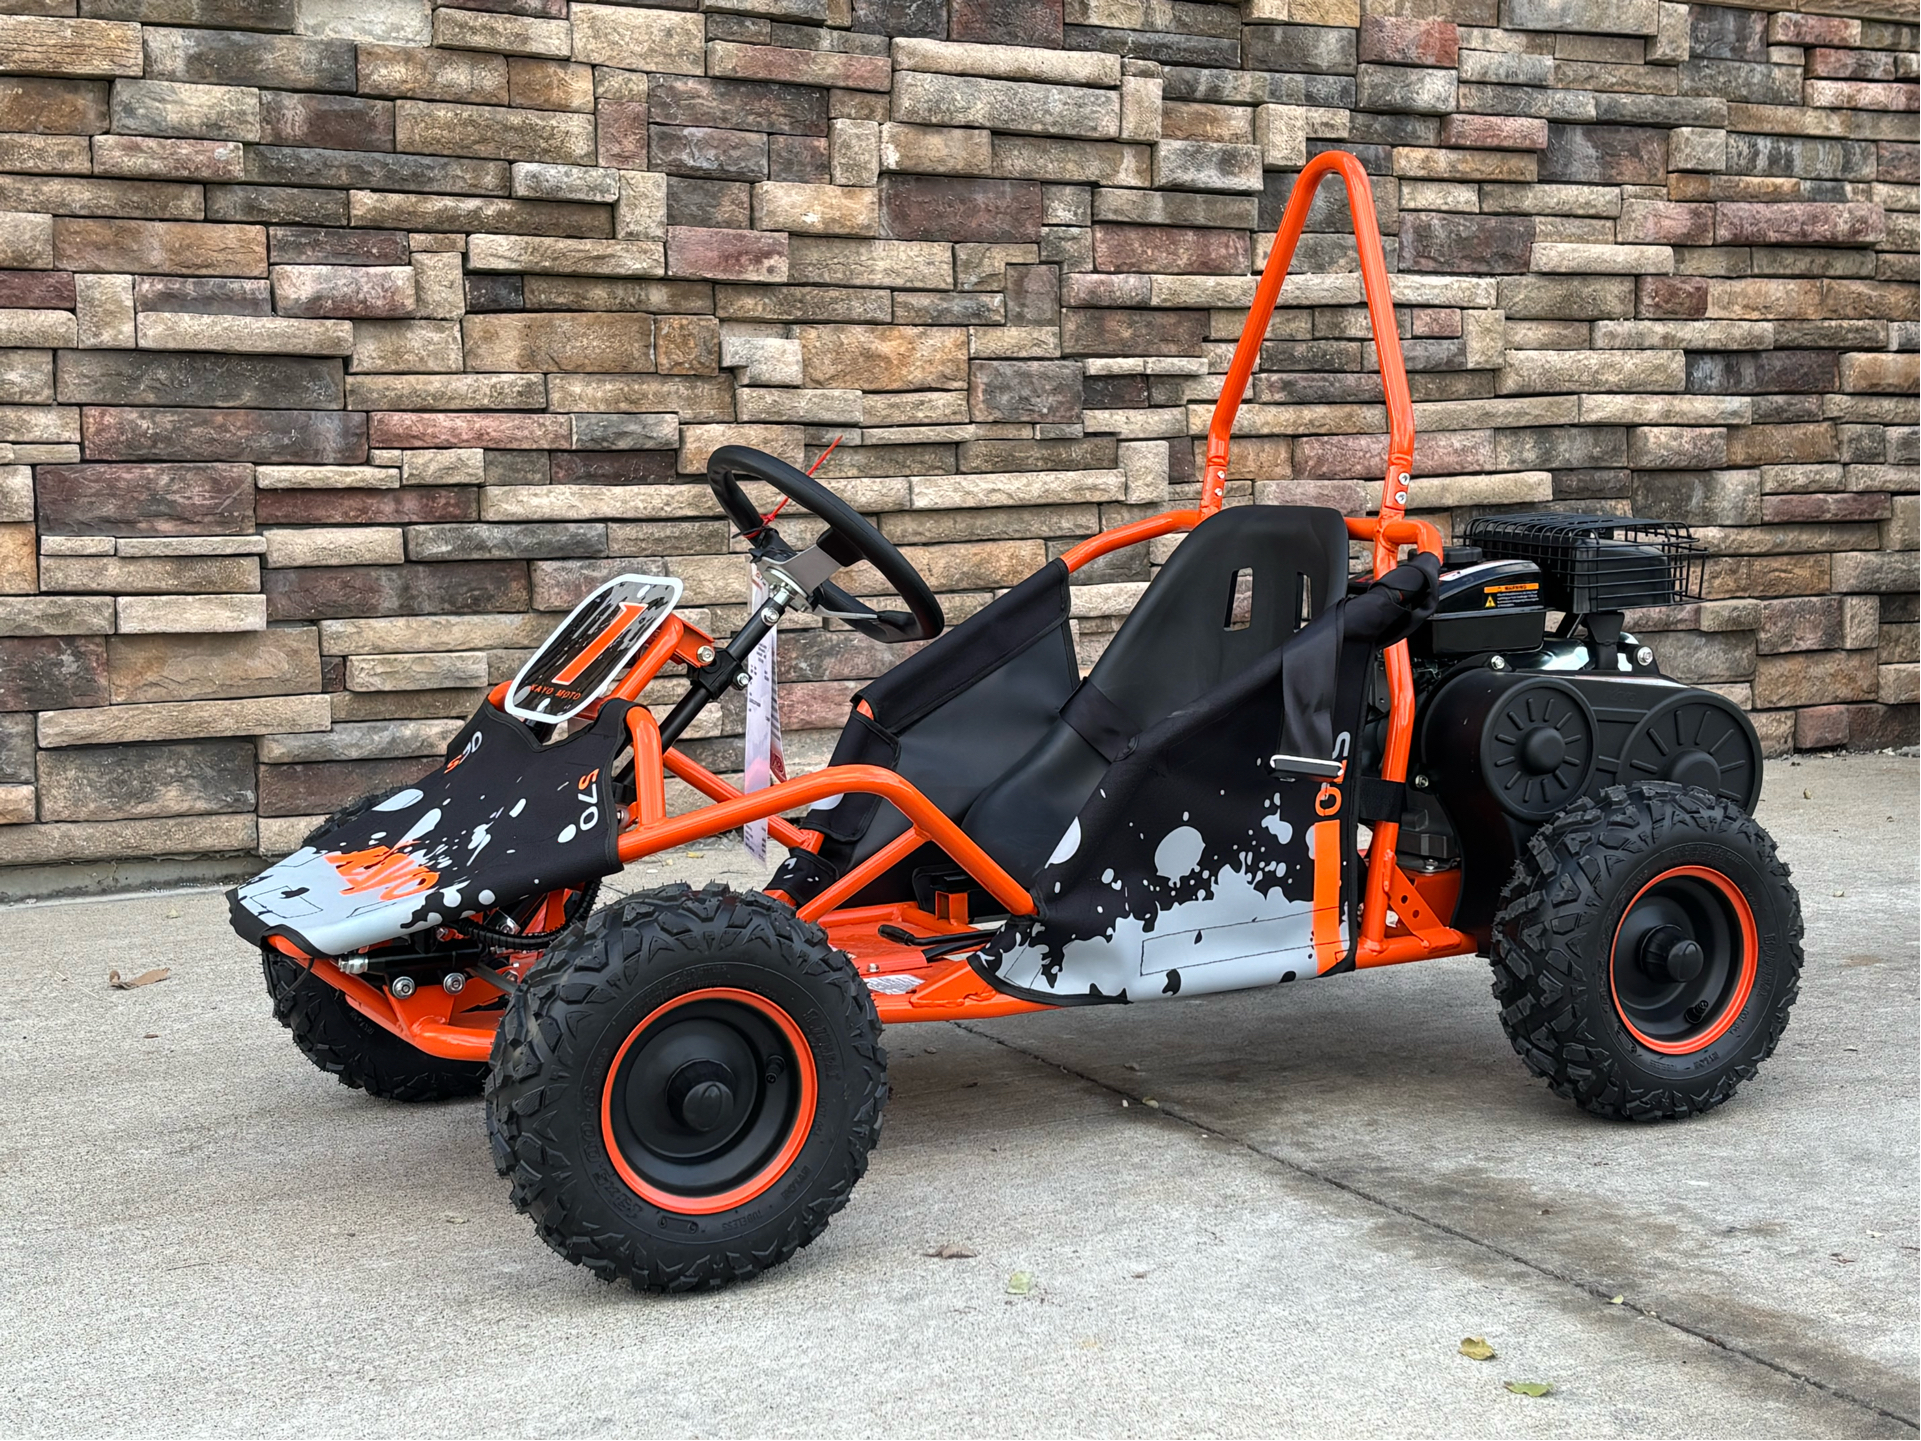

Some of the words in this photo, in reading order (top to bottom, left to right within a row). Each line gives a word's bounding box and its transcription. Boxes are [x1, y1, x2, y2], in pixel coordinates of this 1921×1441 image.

[550, 602, 649, 686] 1
[529, 684, 555, 695] KAYO
[555, 689, 582, 701] MOTO
[443, 731, 483, 774] S70
[578, 768, 600, 831] S70
